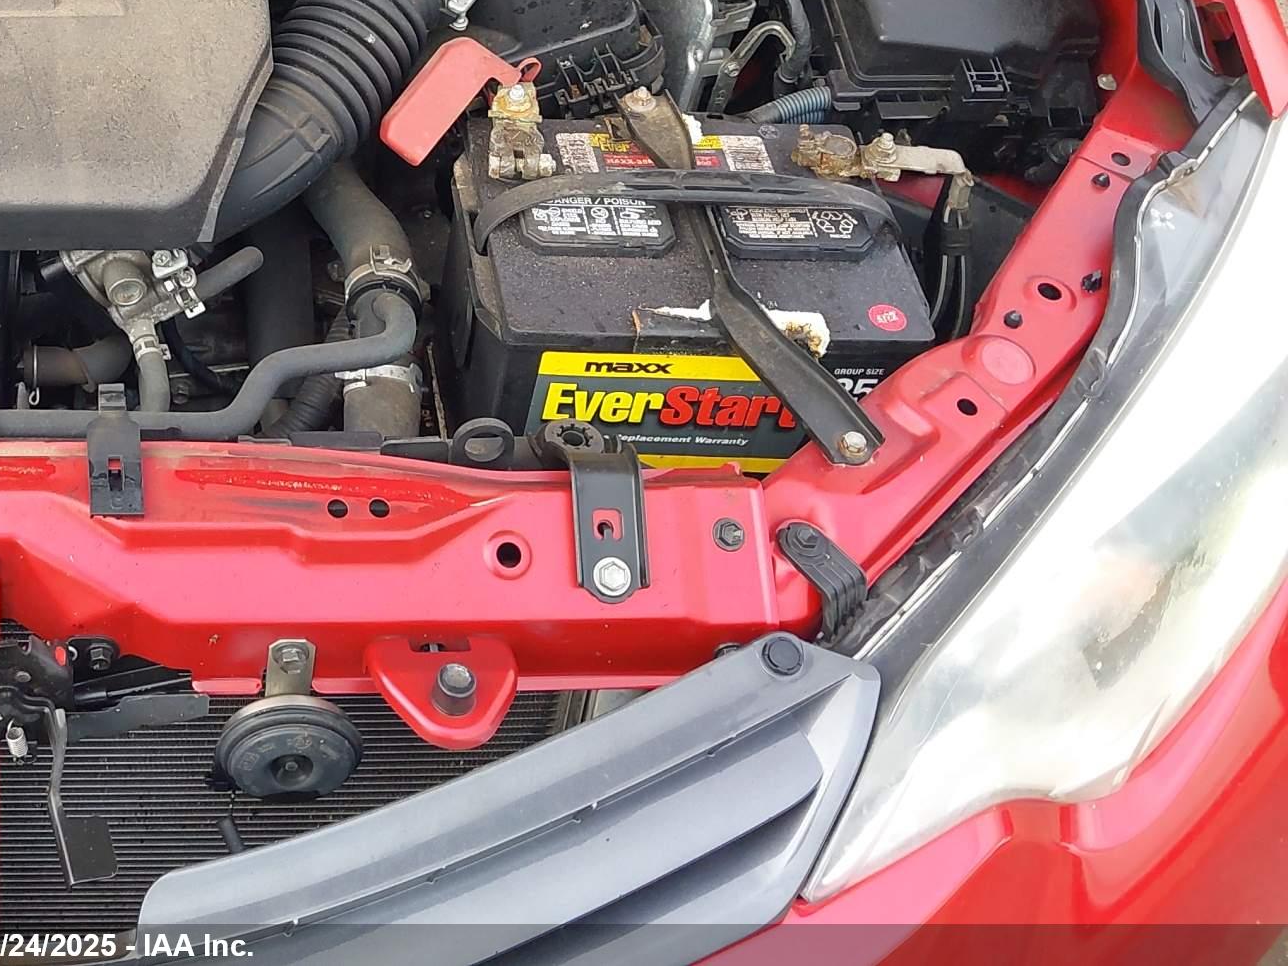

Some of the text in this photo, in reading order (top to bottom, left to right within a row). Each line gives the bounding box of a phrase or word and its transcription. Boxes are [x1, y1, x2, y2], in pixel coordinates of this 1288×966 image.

[547, 197, 592, 205] ANGER
[584, 361, 673, 374] maxx
[618, 434, 749, 447] eplacement Warranty
